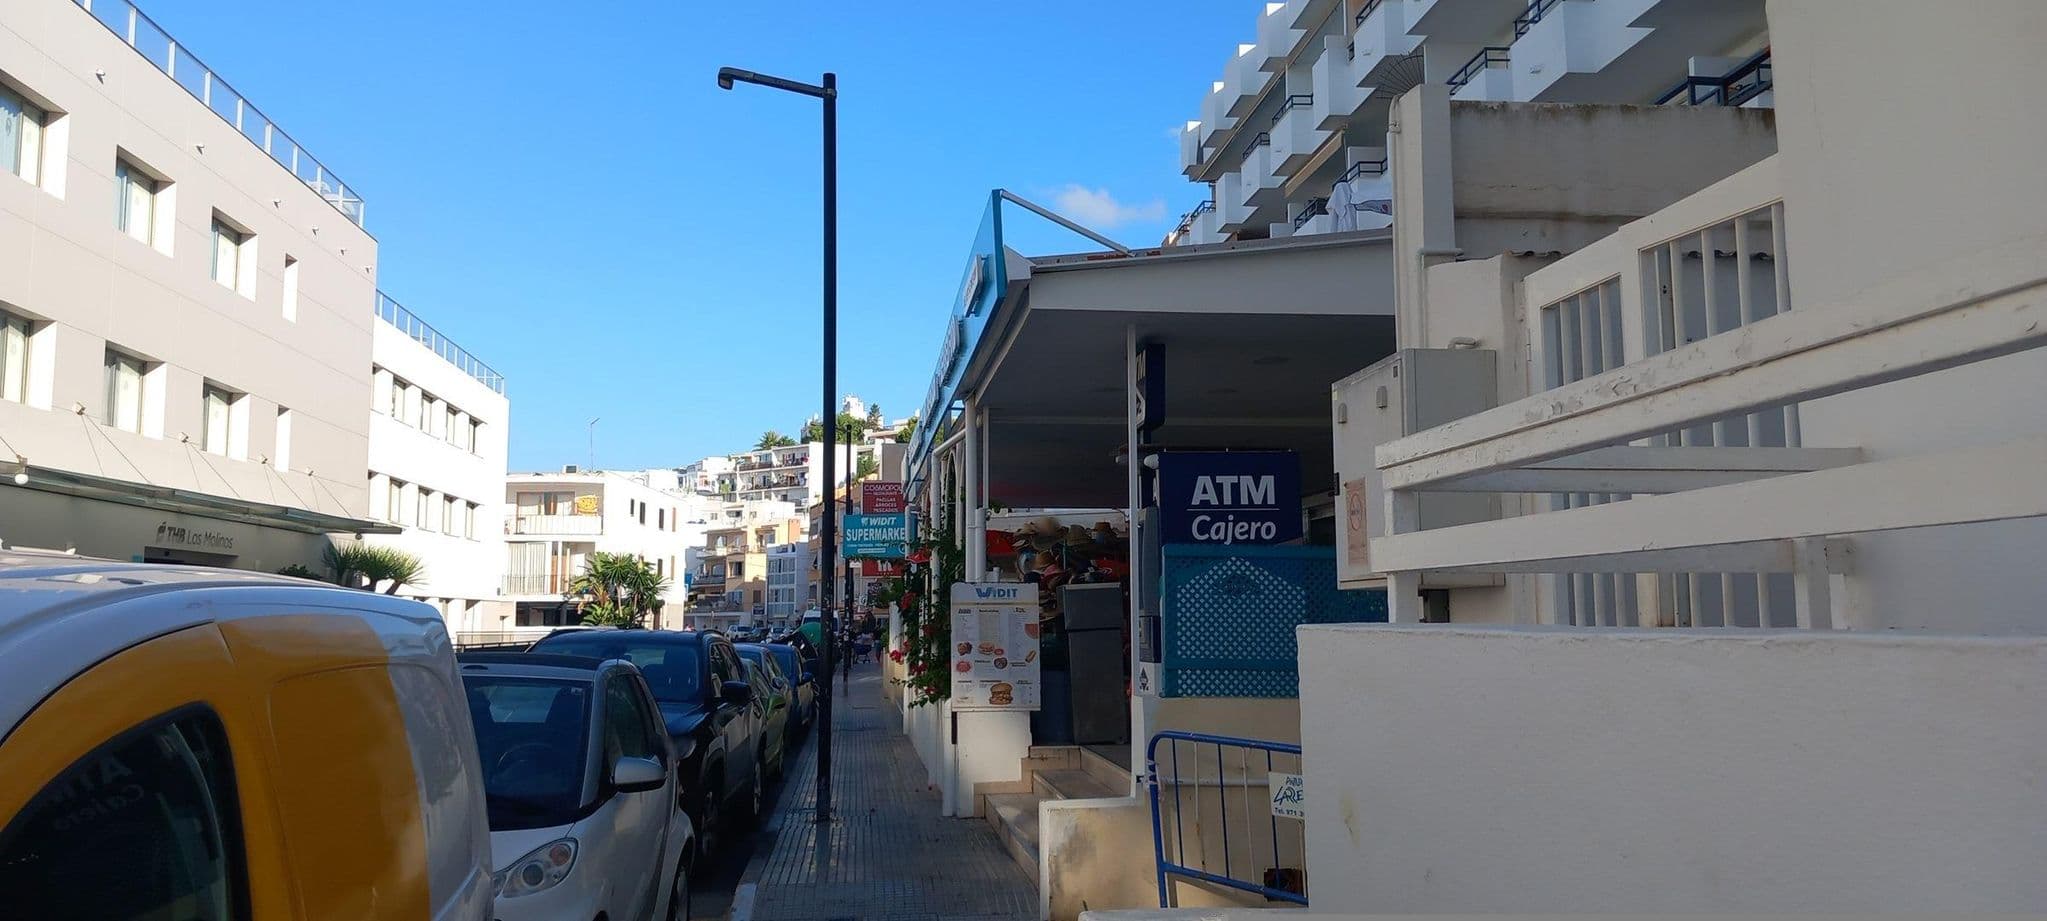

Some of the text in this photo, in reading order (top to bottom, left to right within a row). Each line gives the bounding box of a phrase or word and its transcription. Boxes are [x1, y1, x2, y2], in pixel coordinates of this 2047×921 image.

[1191, 475, 1276, 505] ATM
[869, 517, 897, 526] WIDIT
[1191, 514, 1277, 546] Cajero
[167, 526, 234, 549] THB Los Molinos
[846, 527, 905, 542] SUPERMARKE
[975, 587, 1018, 598] WIDIT
[1274, 786, 1304, 805] LARRE
